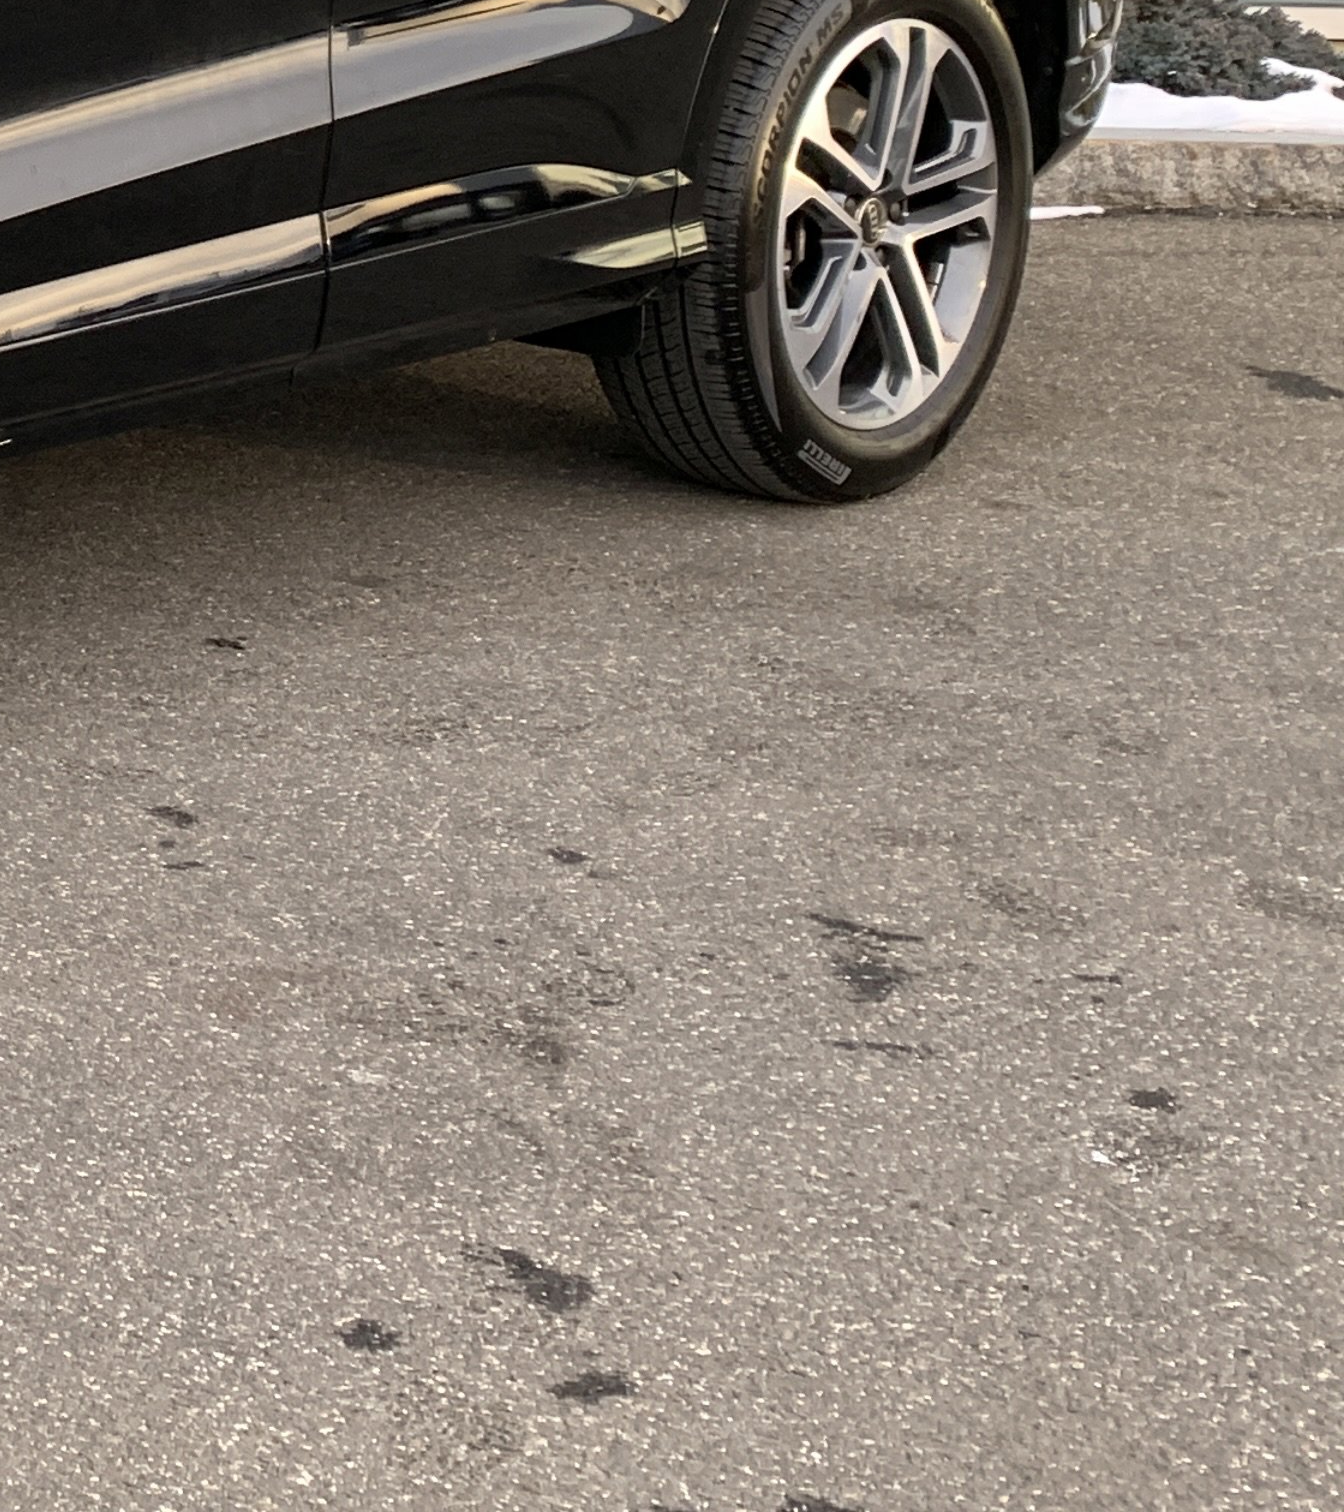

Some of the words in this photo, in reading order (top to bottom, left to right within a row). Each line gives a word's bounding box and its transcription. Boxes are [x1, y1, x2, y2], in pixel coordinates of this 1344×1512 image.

[753, 50, 814, 226] SCORPION
[815, 2, 846, 47] MS
[797, 438, 853, 486] PIRELLI
